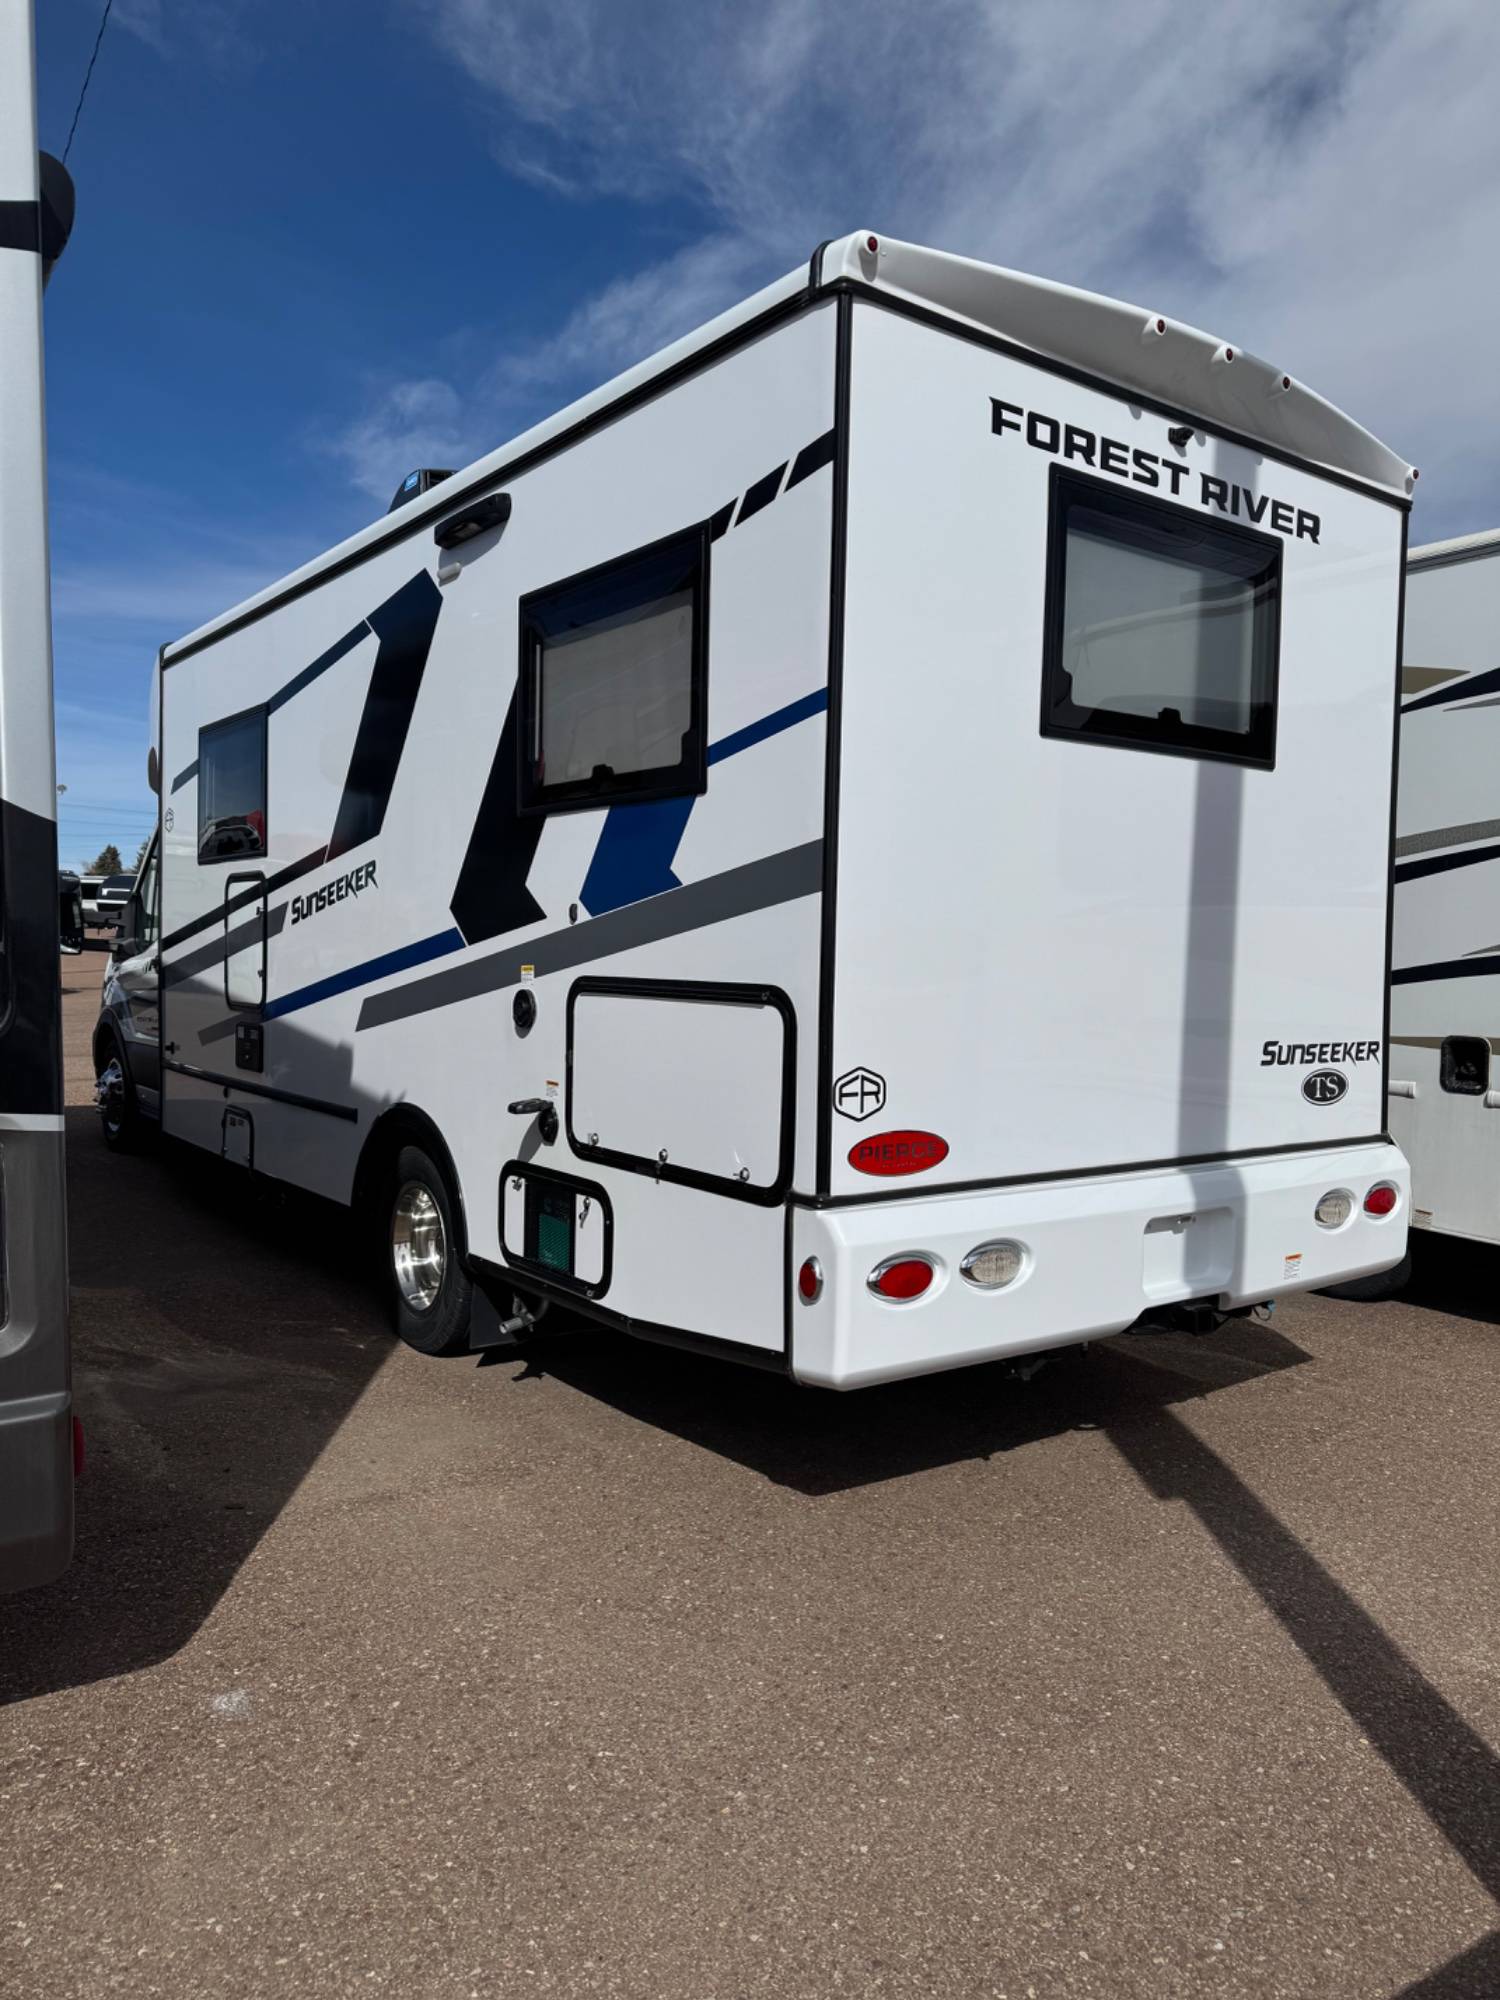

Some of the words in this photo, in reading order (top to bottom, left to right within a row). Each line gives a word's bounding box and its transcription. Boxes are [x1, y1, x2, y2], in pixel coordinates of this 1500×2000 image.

[988, 396, 1190, 496] FOREST
[1199, 471, 1322, 545] RIVER
[1310, 1075, 1340, 1099] TS
[859, 1140, 938, 1163] PIERCE
